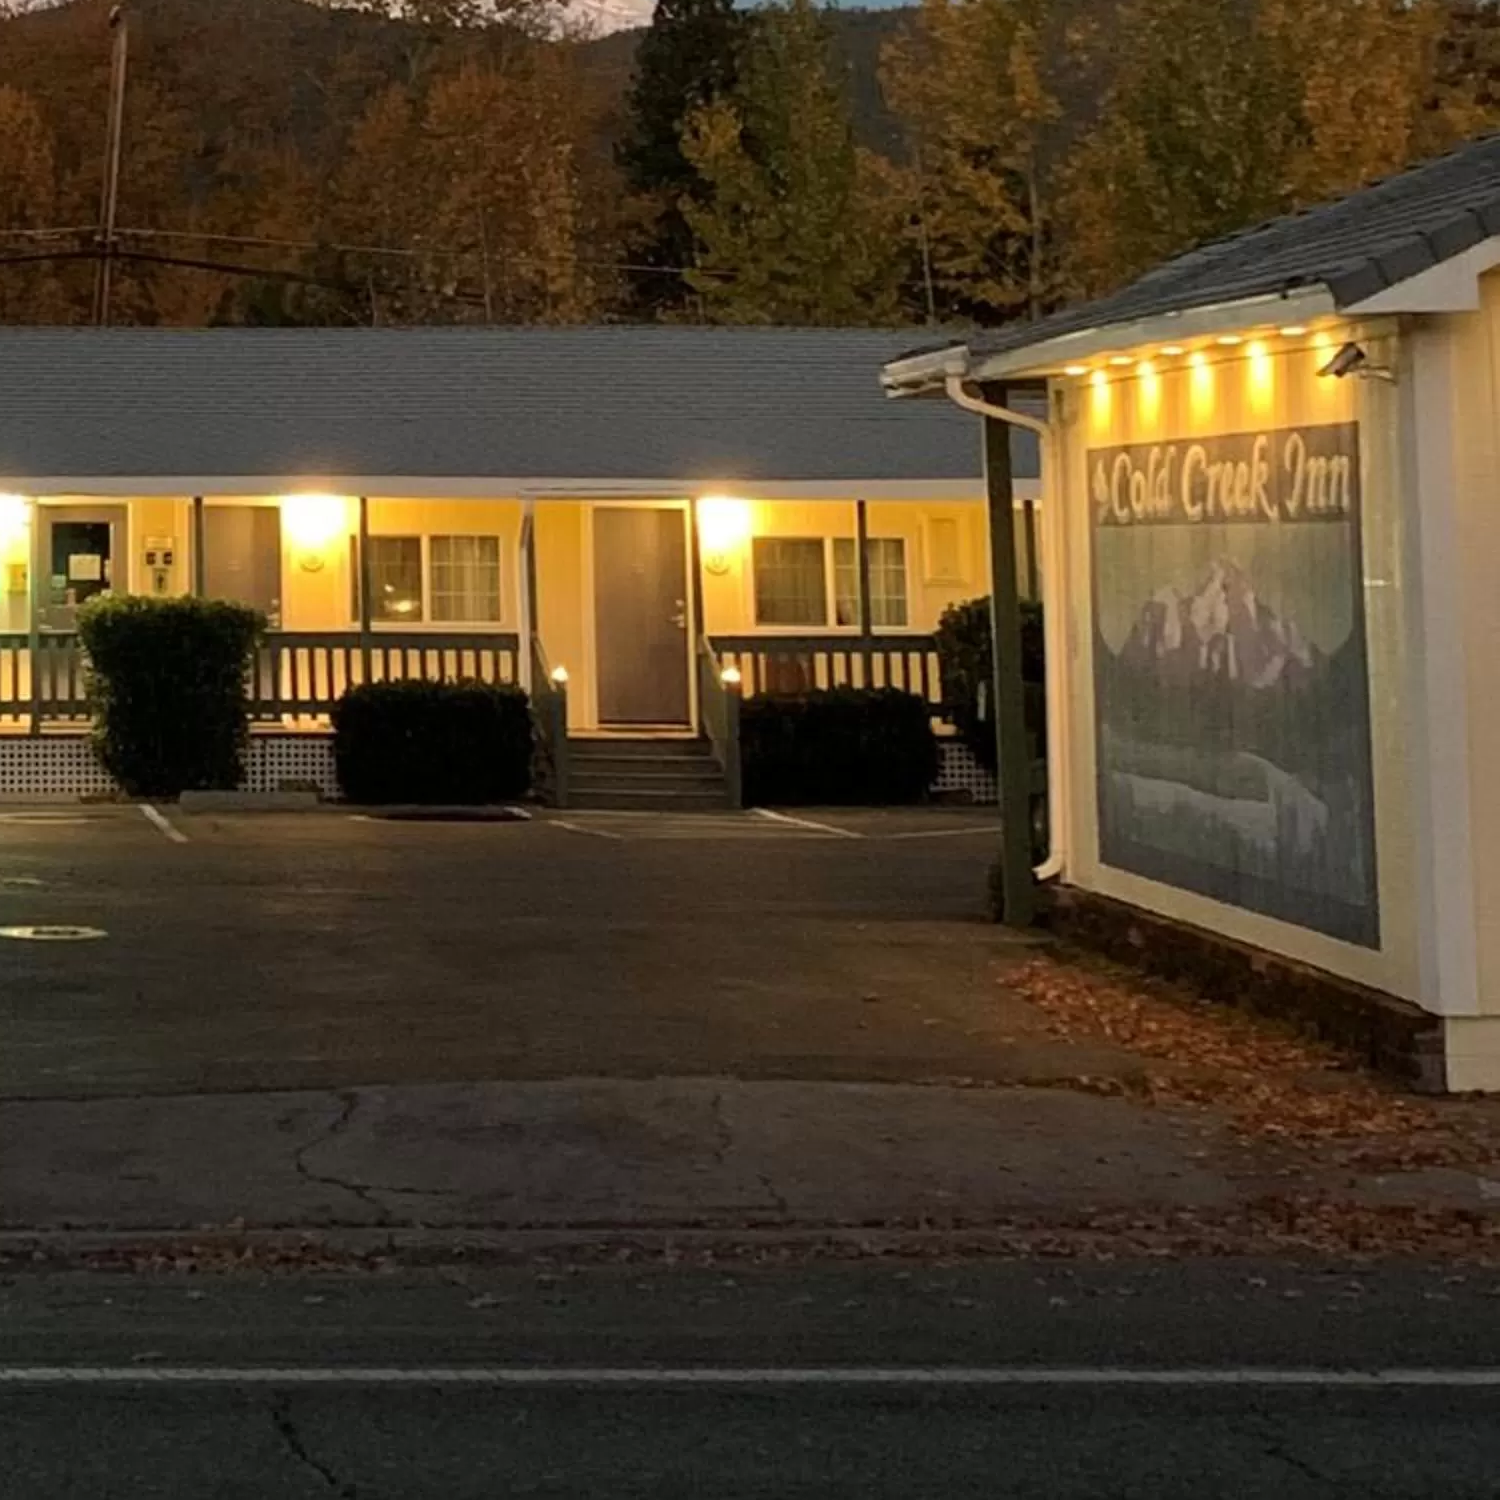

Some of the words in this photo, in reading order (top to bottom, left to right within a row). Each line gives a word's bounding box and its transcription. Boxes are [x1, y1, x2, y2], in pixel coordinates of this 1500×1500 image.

[1111, 445, 1177, 524] Cold
[1181, 433, 1279, 523] Creek
[1284, 431, 1350, 519] Inn
